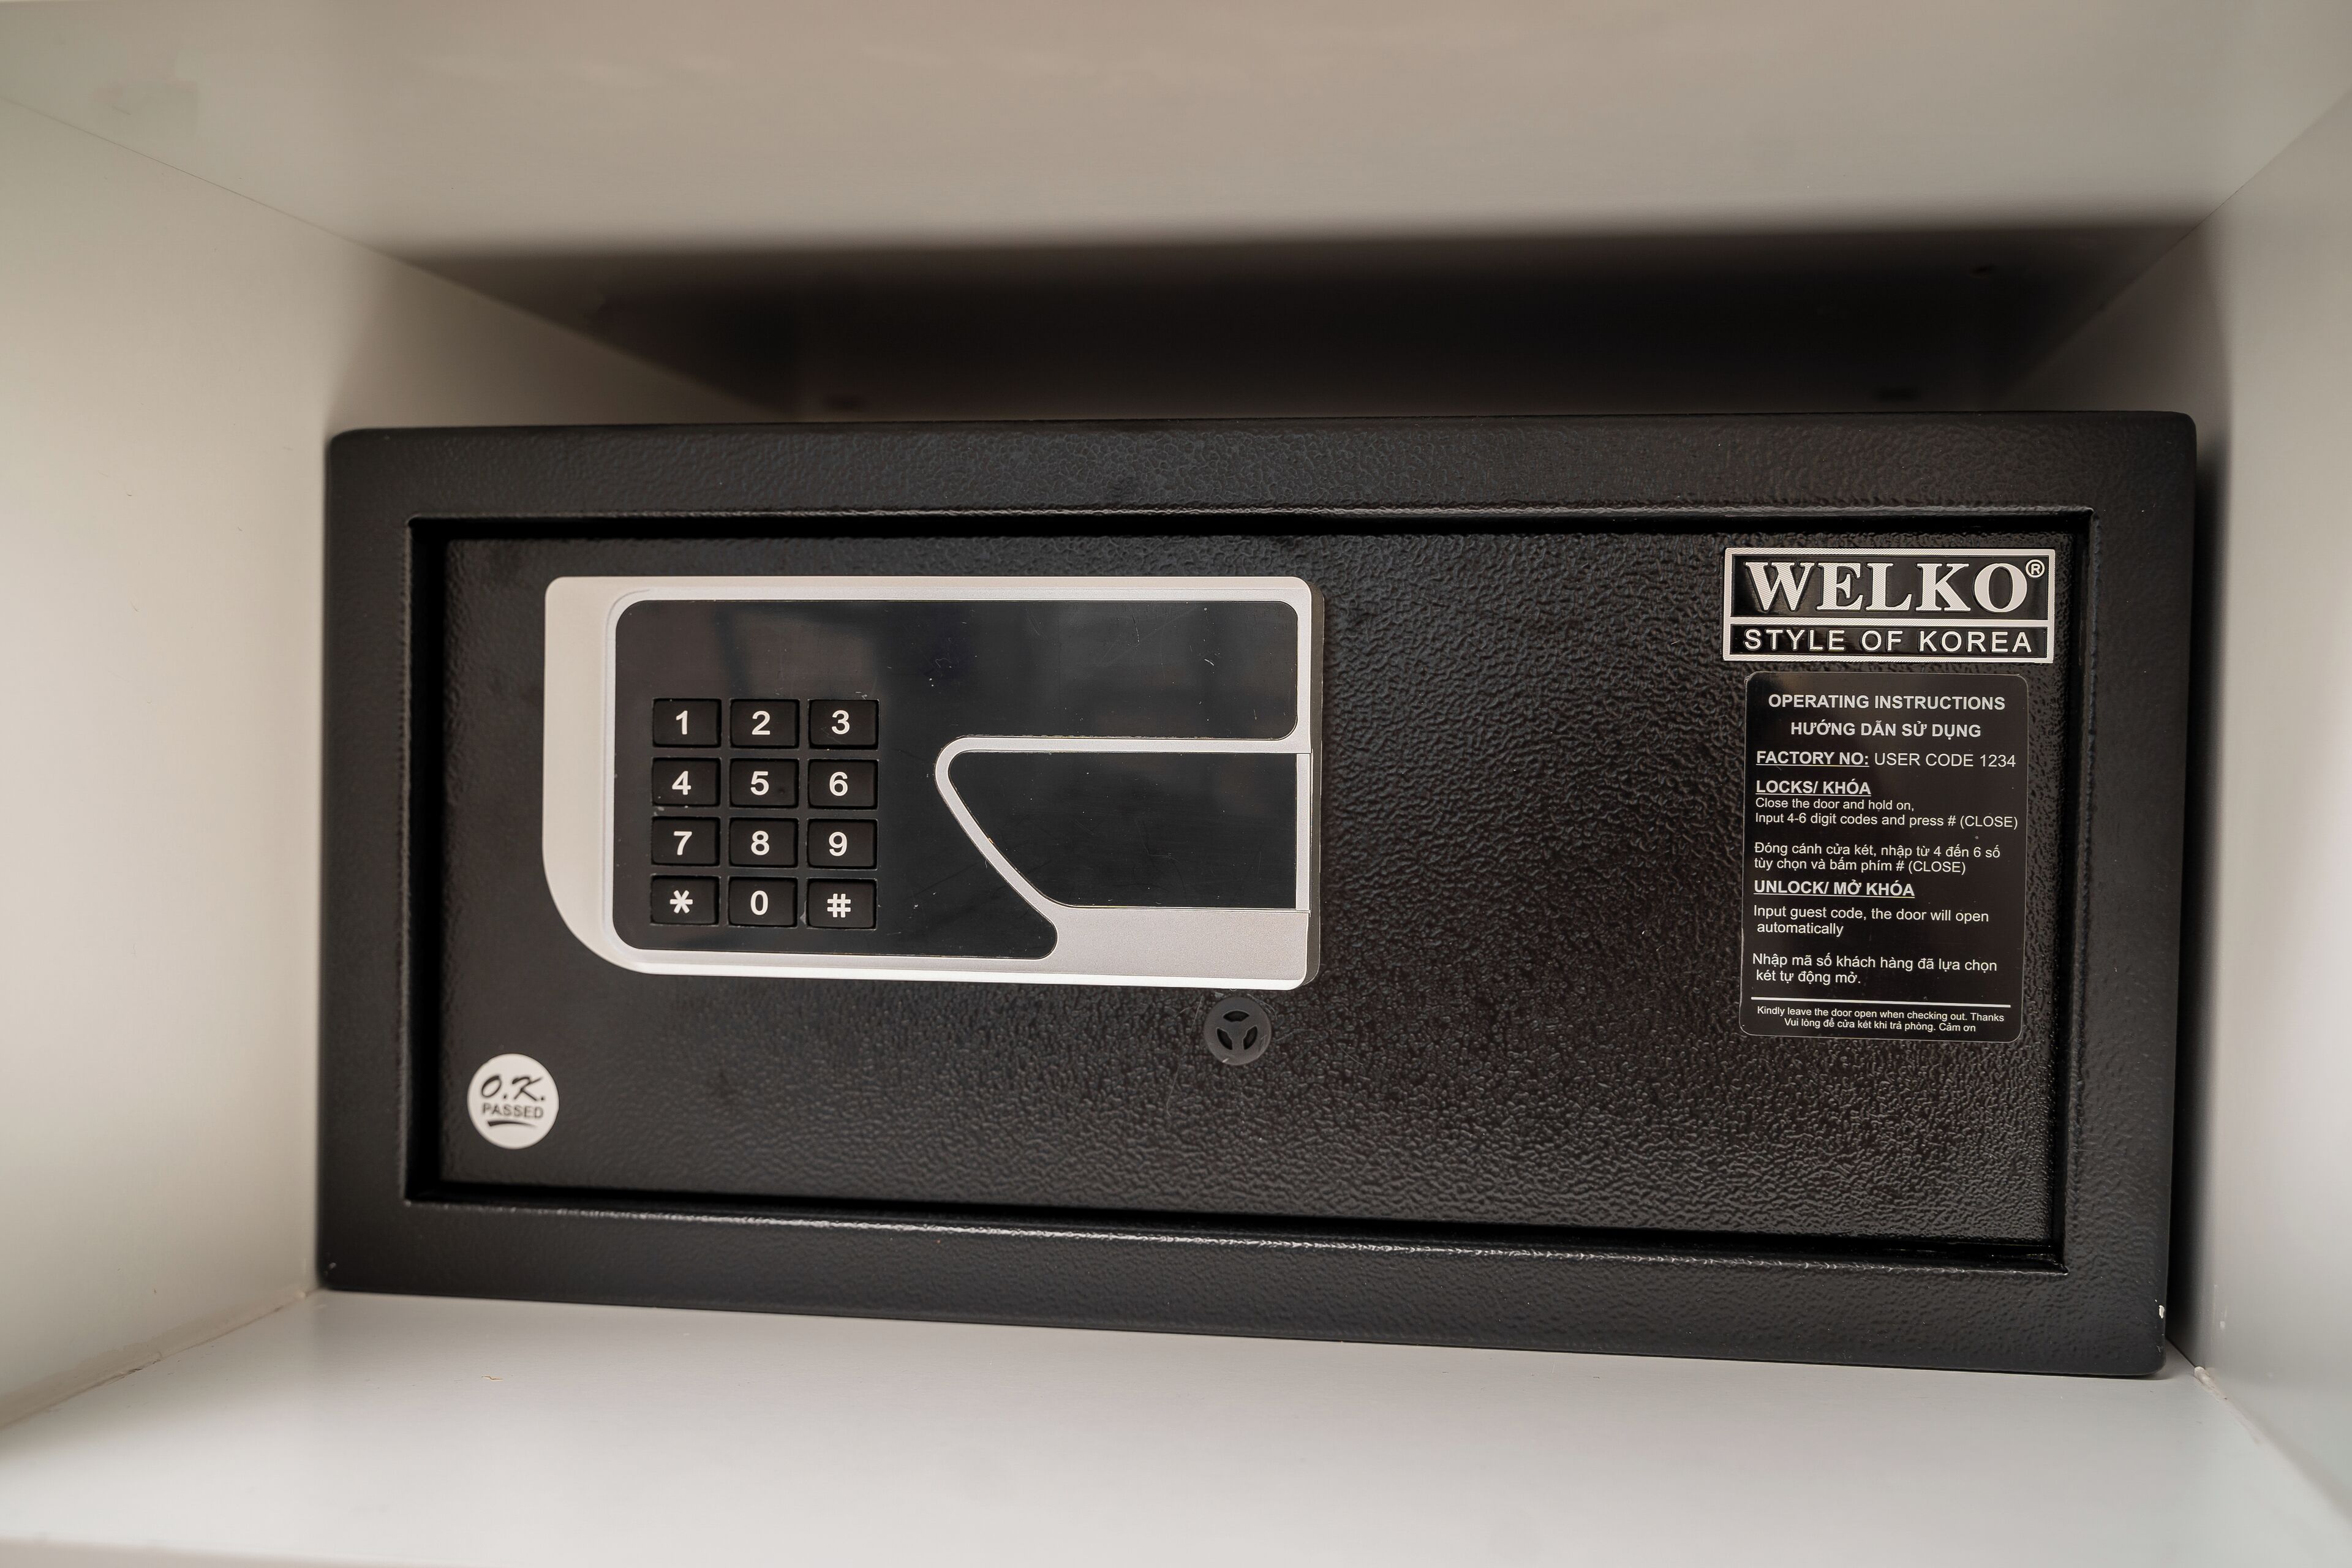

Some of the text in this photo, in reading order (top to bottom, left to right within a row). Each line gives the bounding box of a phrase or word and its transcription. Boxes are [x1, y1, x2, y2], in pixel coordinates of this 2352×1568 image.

[1744, 629, 2032, 652] STYLE OF KOREA
[1768, 693, 2006, 710] OPERATING INSTRUCTIONS
[676, 710, 850, 735] 1 2 3
[1790, 718, 1981, 741] HƯỚNG DẪN SỬ DỤNG
[1756, 750, 2016, 767] FACTORY NO: USER CODE 1234
[672, 771, 848, 796] 4 5 6
[1756, 778, 1872, 795] LOCKS/ KHÓA
[1755, 797, 1915, 813] Close the door and hold on,
[1755, 812, 2018, 829] Input 4-6 digit codes and press # (CLOSE)
[674, 831, 847, 856] 7 8 9
[1754, 842, 2001, 860] Đóng cánh cửa két, nhập từ 4 đến 6 số
[1754, 856, 1967, 875] tùy chọn và bấm phím # (CLOSE)
[1754, 879, 1915, 897] UNLOCK/ MỞ KHÓA
[750, 891, 768, 915] 0
[827, 894, 851, 918] #
[1753, 904, 1989, 924] Input guest code, the door will open
[1756, 922, 1844, 937] automatically
[1752, 952, 1997, 974] Nhập mã số khách hàng đã lựa chọn
[1756, 970, 1861, 986] két tự động mở.
[1757, 1006, 2005, 1022] Kindly leave the door open when checking out. Thanks
[1784, 1018, 1799, 1027] Vui
[1801, 1019, 1820, 1030] lòng
[1822, 1017, 1837, 1028] để
[1838, 1018, 1856, 1028] cửa
[1857, 1020, 1872, 1030] két
[1874, 1020, 1888, 1030] khi
[1889, 1020, 1902, 1030] trả
[1904, 1020, 1936, 1033] phòng.
[1962, 1023, 1977, 1032] ơn
[481, 1075, 545, 1101] O.K.
[483, 1103, 543, 1118] PASSED
